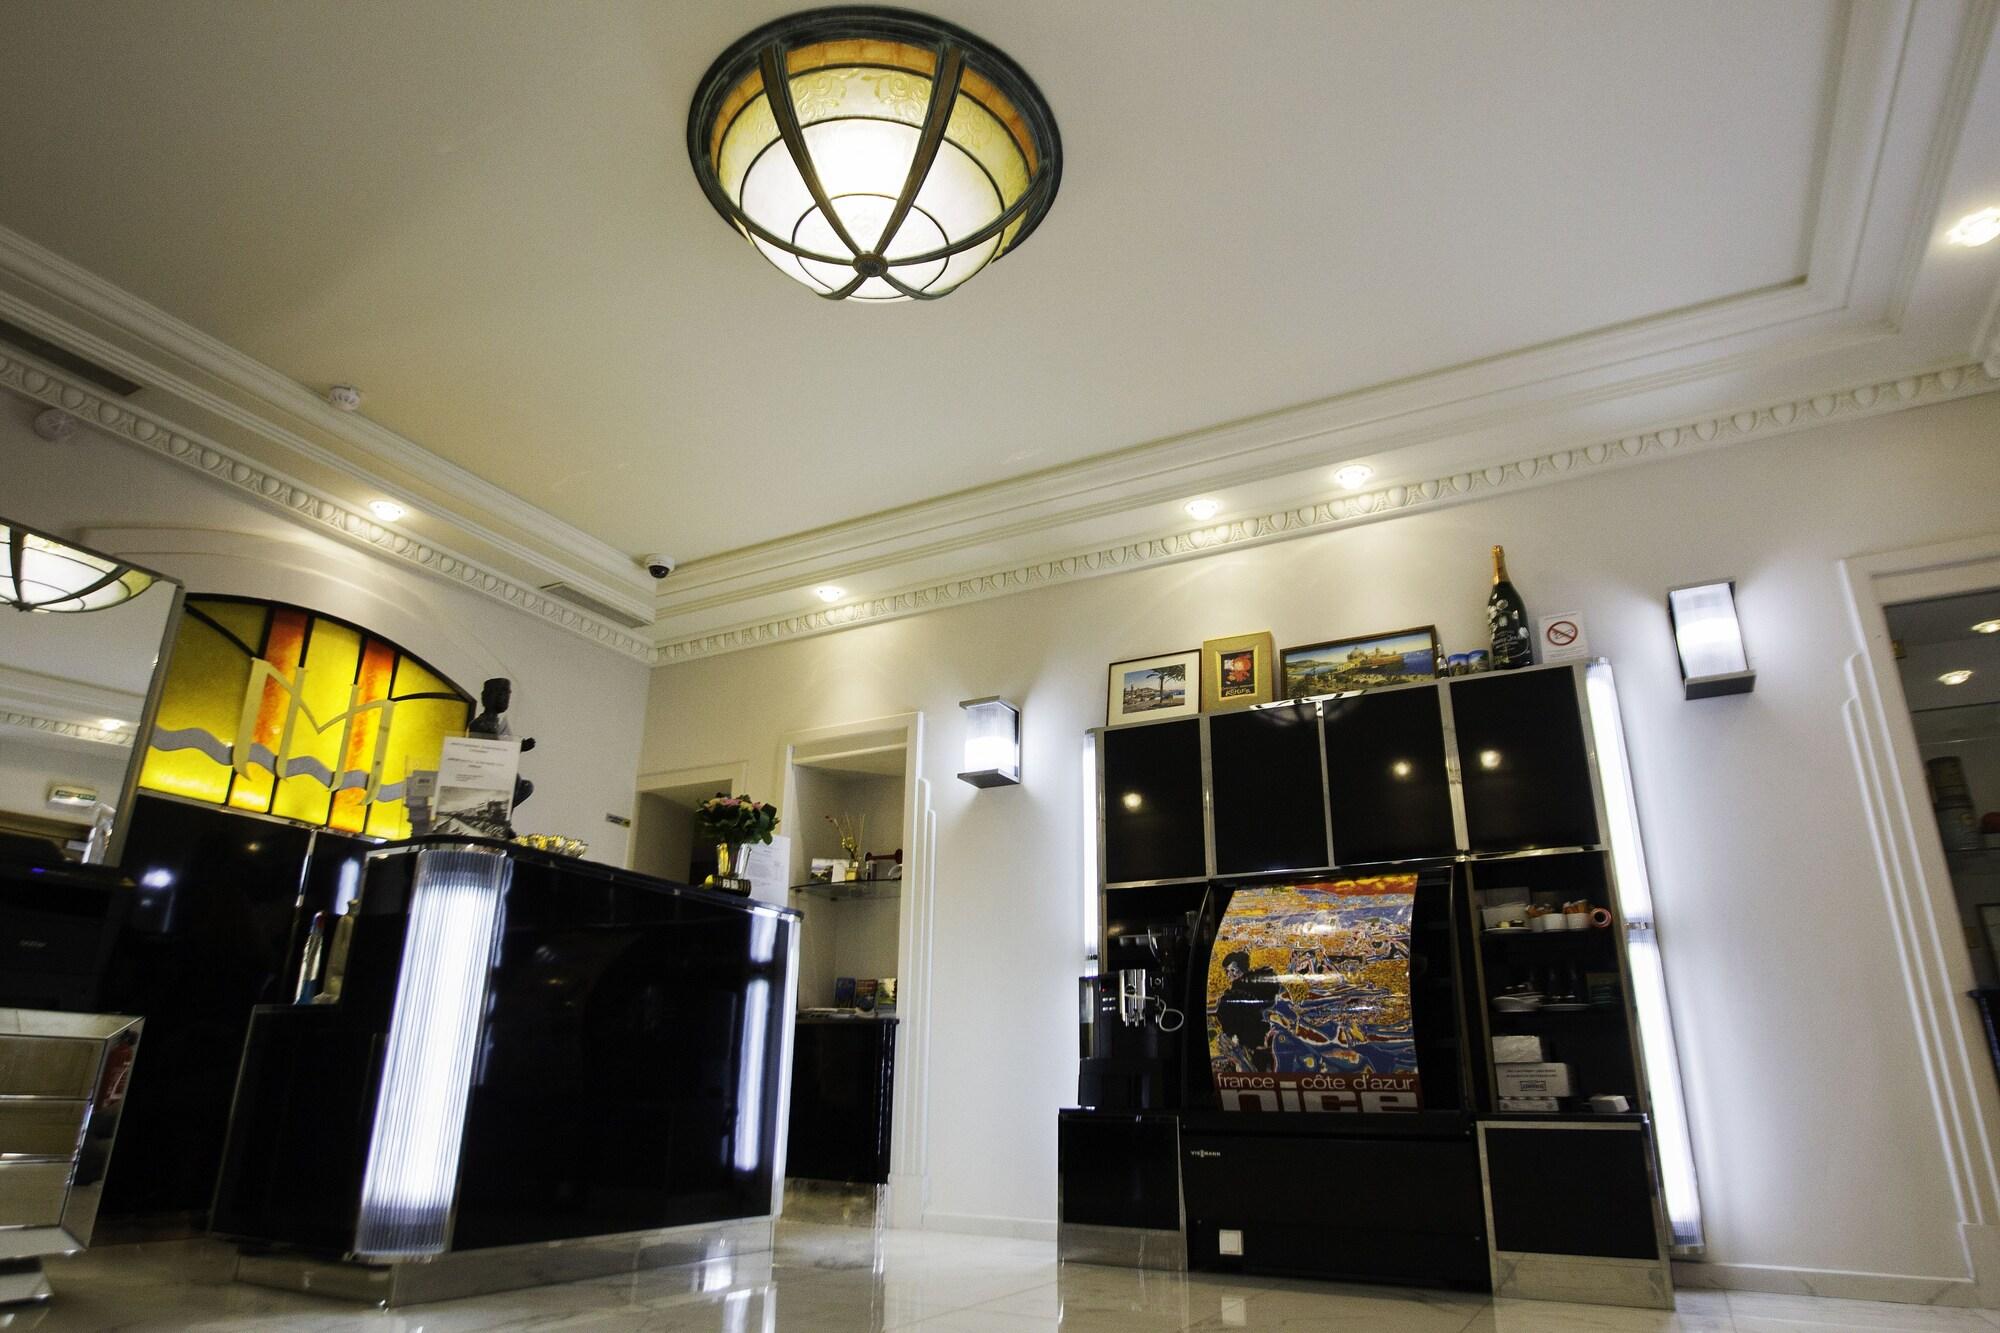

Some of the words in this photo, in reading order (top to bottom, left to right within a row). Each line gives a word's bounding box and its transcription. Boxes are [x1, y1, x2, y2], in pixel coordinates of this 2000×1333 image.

[1217, 1074, 1275, 1089] france
[1301, 1074, 1346, 1089] côte
[1353, 1075, 1414, 1090] d'azur
[1220, 1082, 1417, 1113] nice
